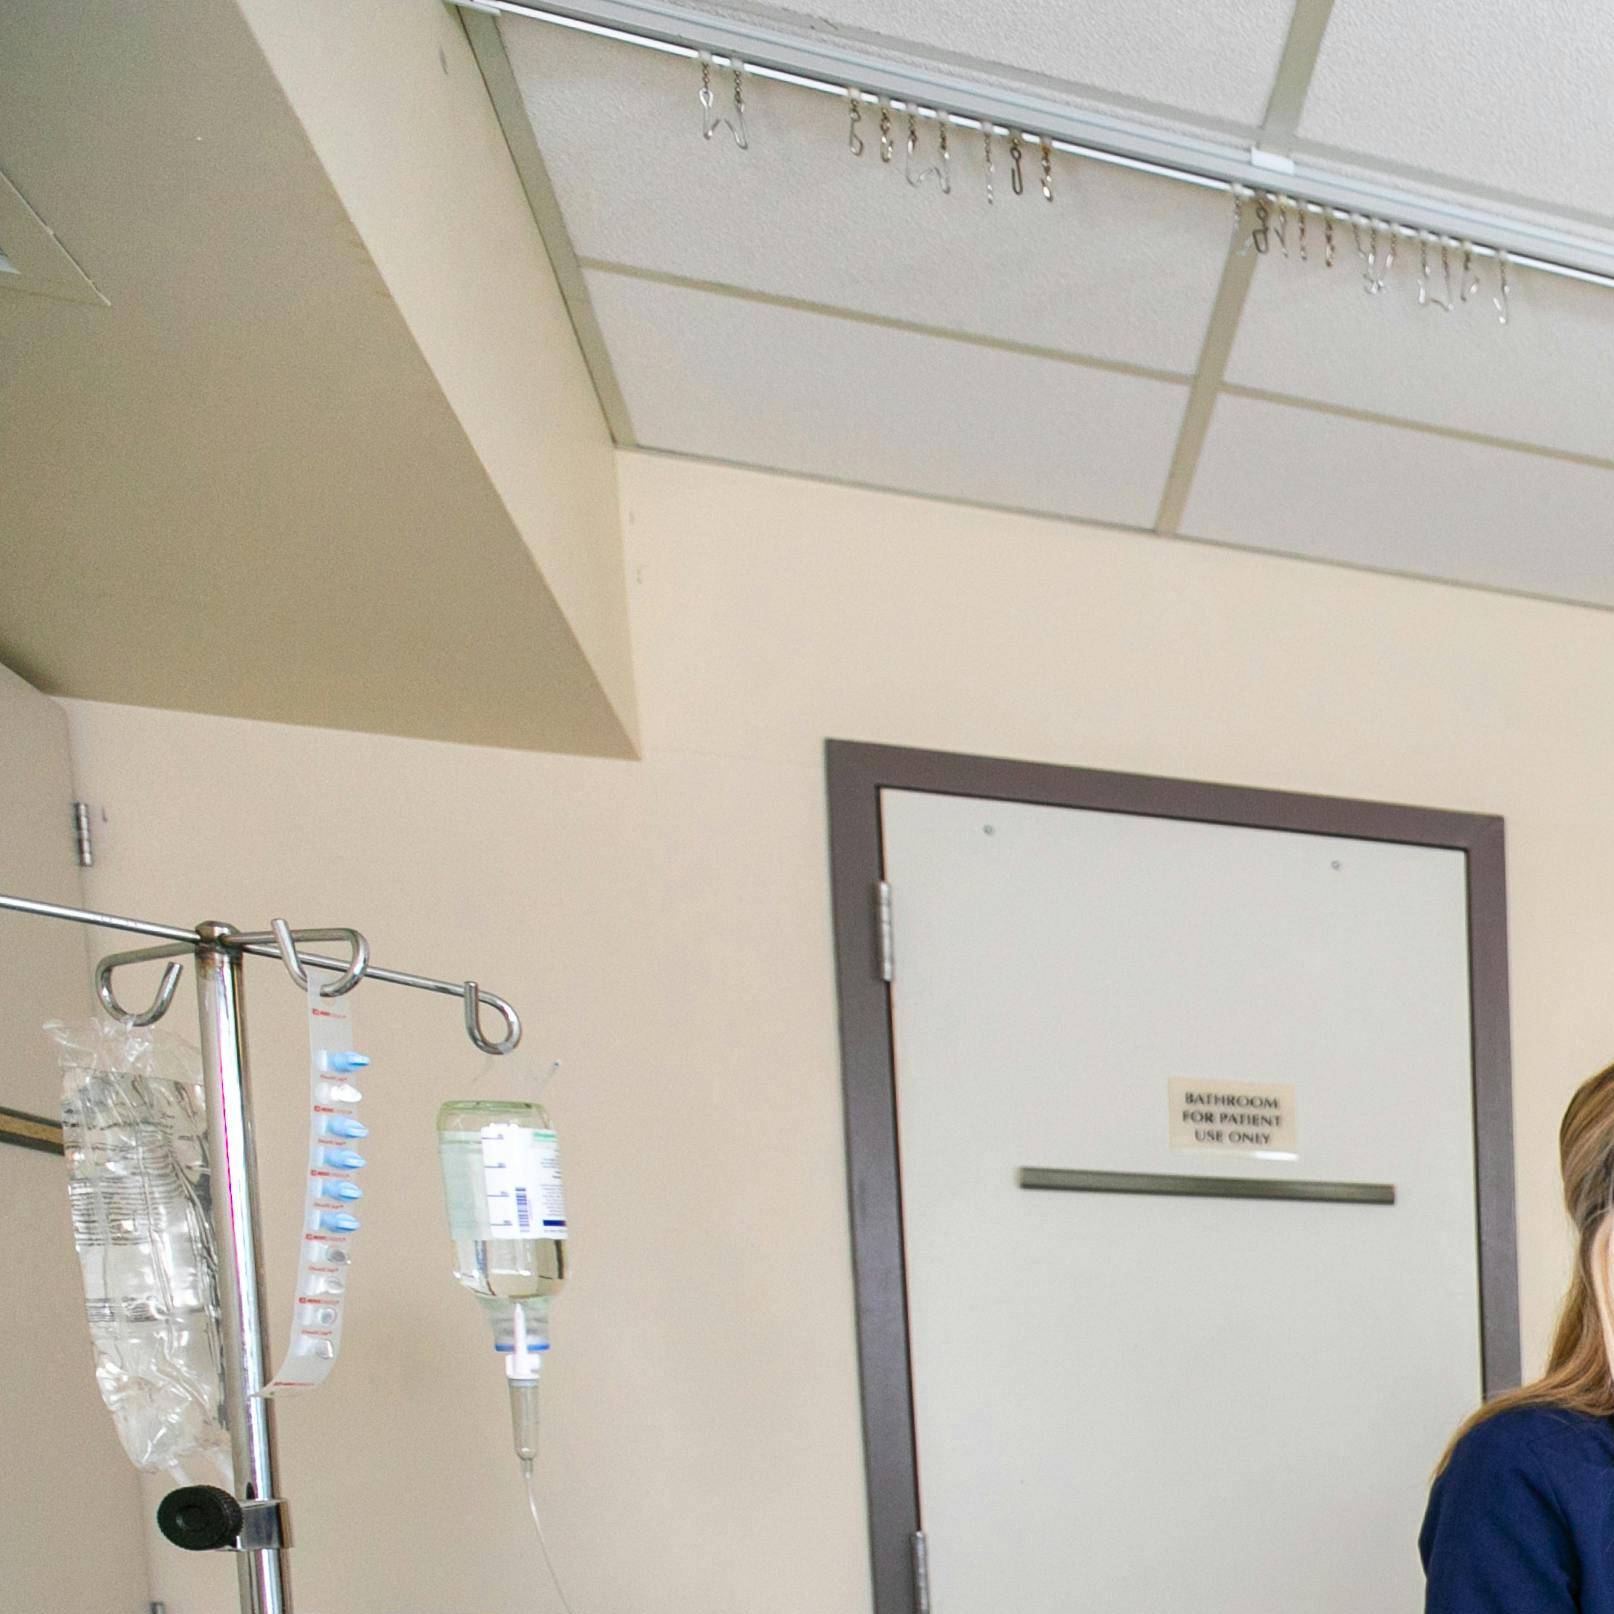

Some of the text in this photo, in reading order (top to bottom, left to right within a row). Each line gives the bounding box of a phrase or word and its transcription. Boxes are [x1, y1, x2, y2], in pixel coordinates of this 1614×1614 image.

[1185, 1091, 1278, 1109] BATHROOM
[1182, 1110, 1282, 1127] FOR PATIENT
[1194, 1129, 1272, 1145] USE ONLY
